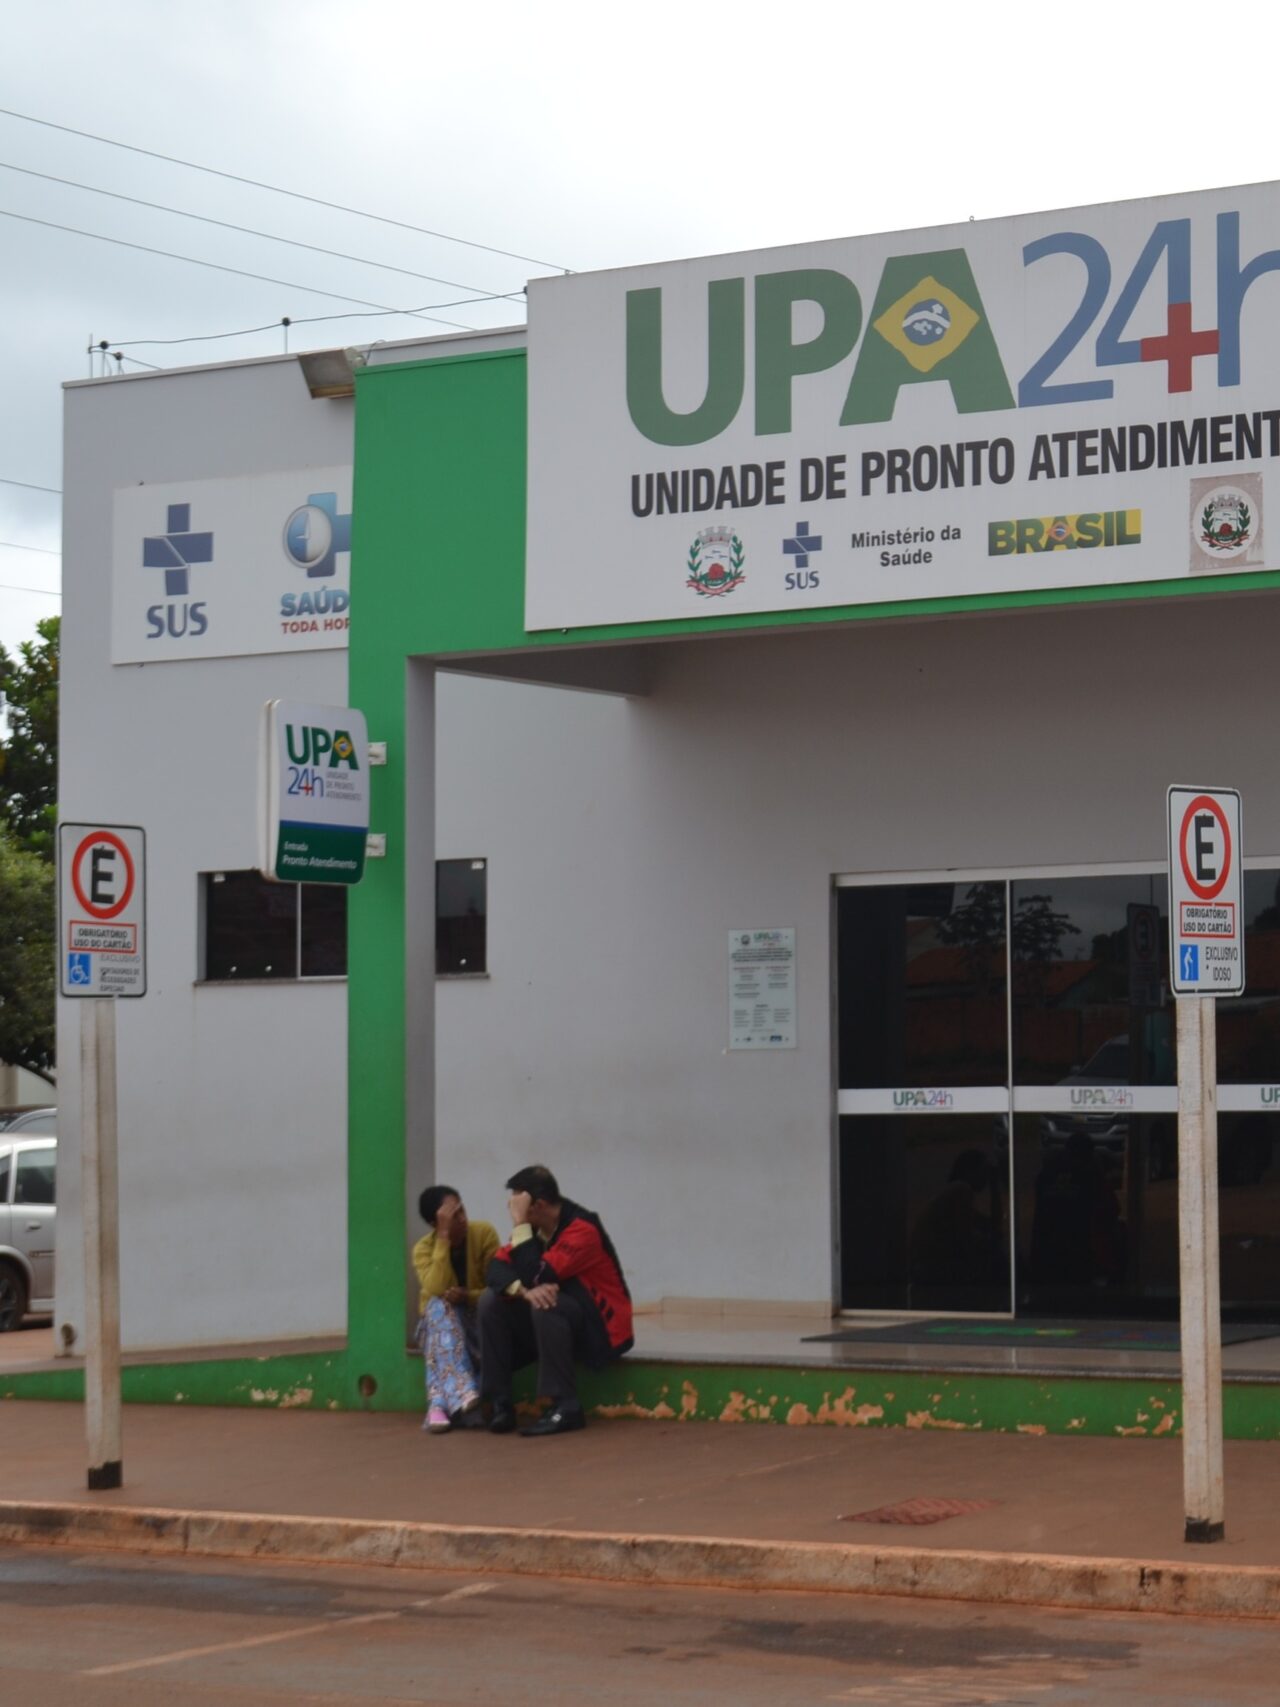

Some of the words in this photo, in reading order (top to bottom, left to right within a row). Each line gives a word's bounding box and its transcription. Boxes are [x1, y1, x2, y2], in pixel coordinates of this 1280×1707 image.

[631, 461, 785, 518] UNIDADE
[800, 455, 846, 502] DE
[861, 437, 1015, 497] PRONTO
[851, 527, 935, 549] Ministério
[941, 525, 961, 541] da
[988, 508, 1142, 556] BRASIL
[880, 549, 933, 567] Saúde
[785, 571, 820, 591] SUS
[280, 585, 349, 617] SAÚD
[147, 602, 209, 639] SUS
[281, 620, 319, 634] TODA
[286, 724, 359, 770] UPA
[288, 766, 324, 797] 24h
[1195, 814, 1216, 880] E
[283, 854, 308, 866] Pronto
[309, 856, 358, 869] Atendimento
[91, 847, 116, 905] E
[1186, 906, 1228, 919] OBRIGATÓRIO
[1184, 922, 1196, 932] USO
[1197, 922, 1206, 932] DO
[1206, 946, 1238, 960] EXCLUSIVO
[1213, 967, 1231, 981] IDOSO
